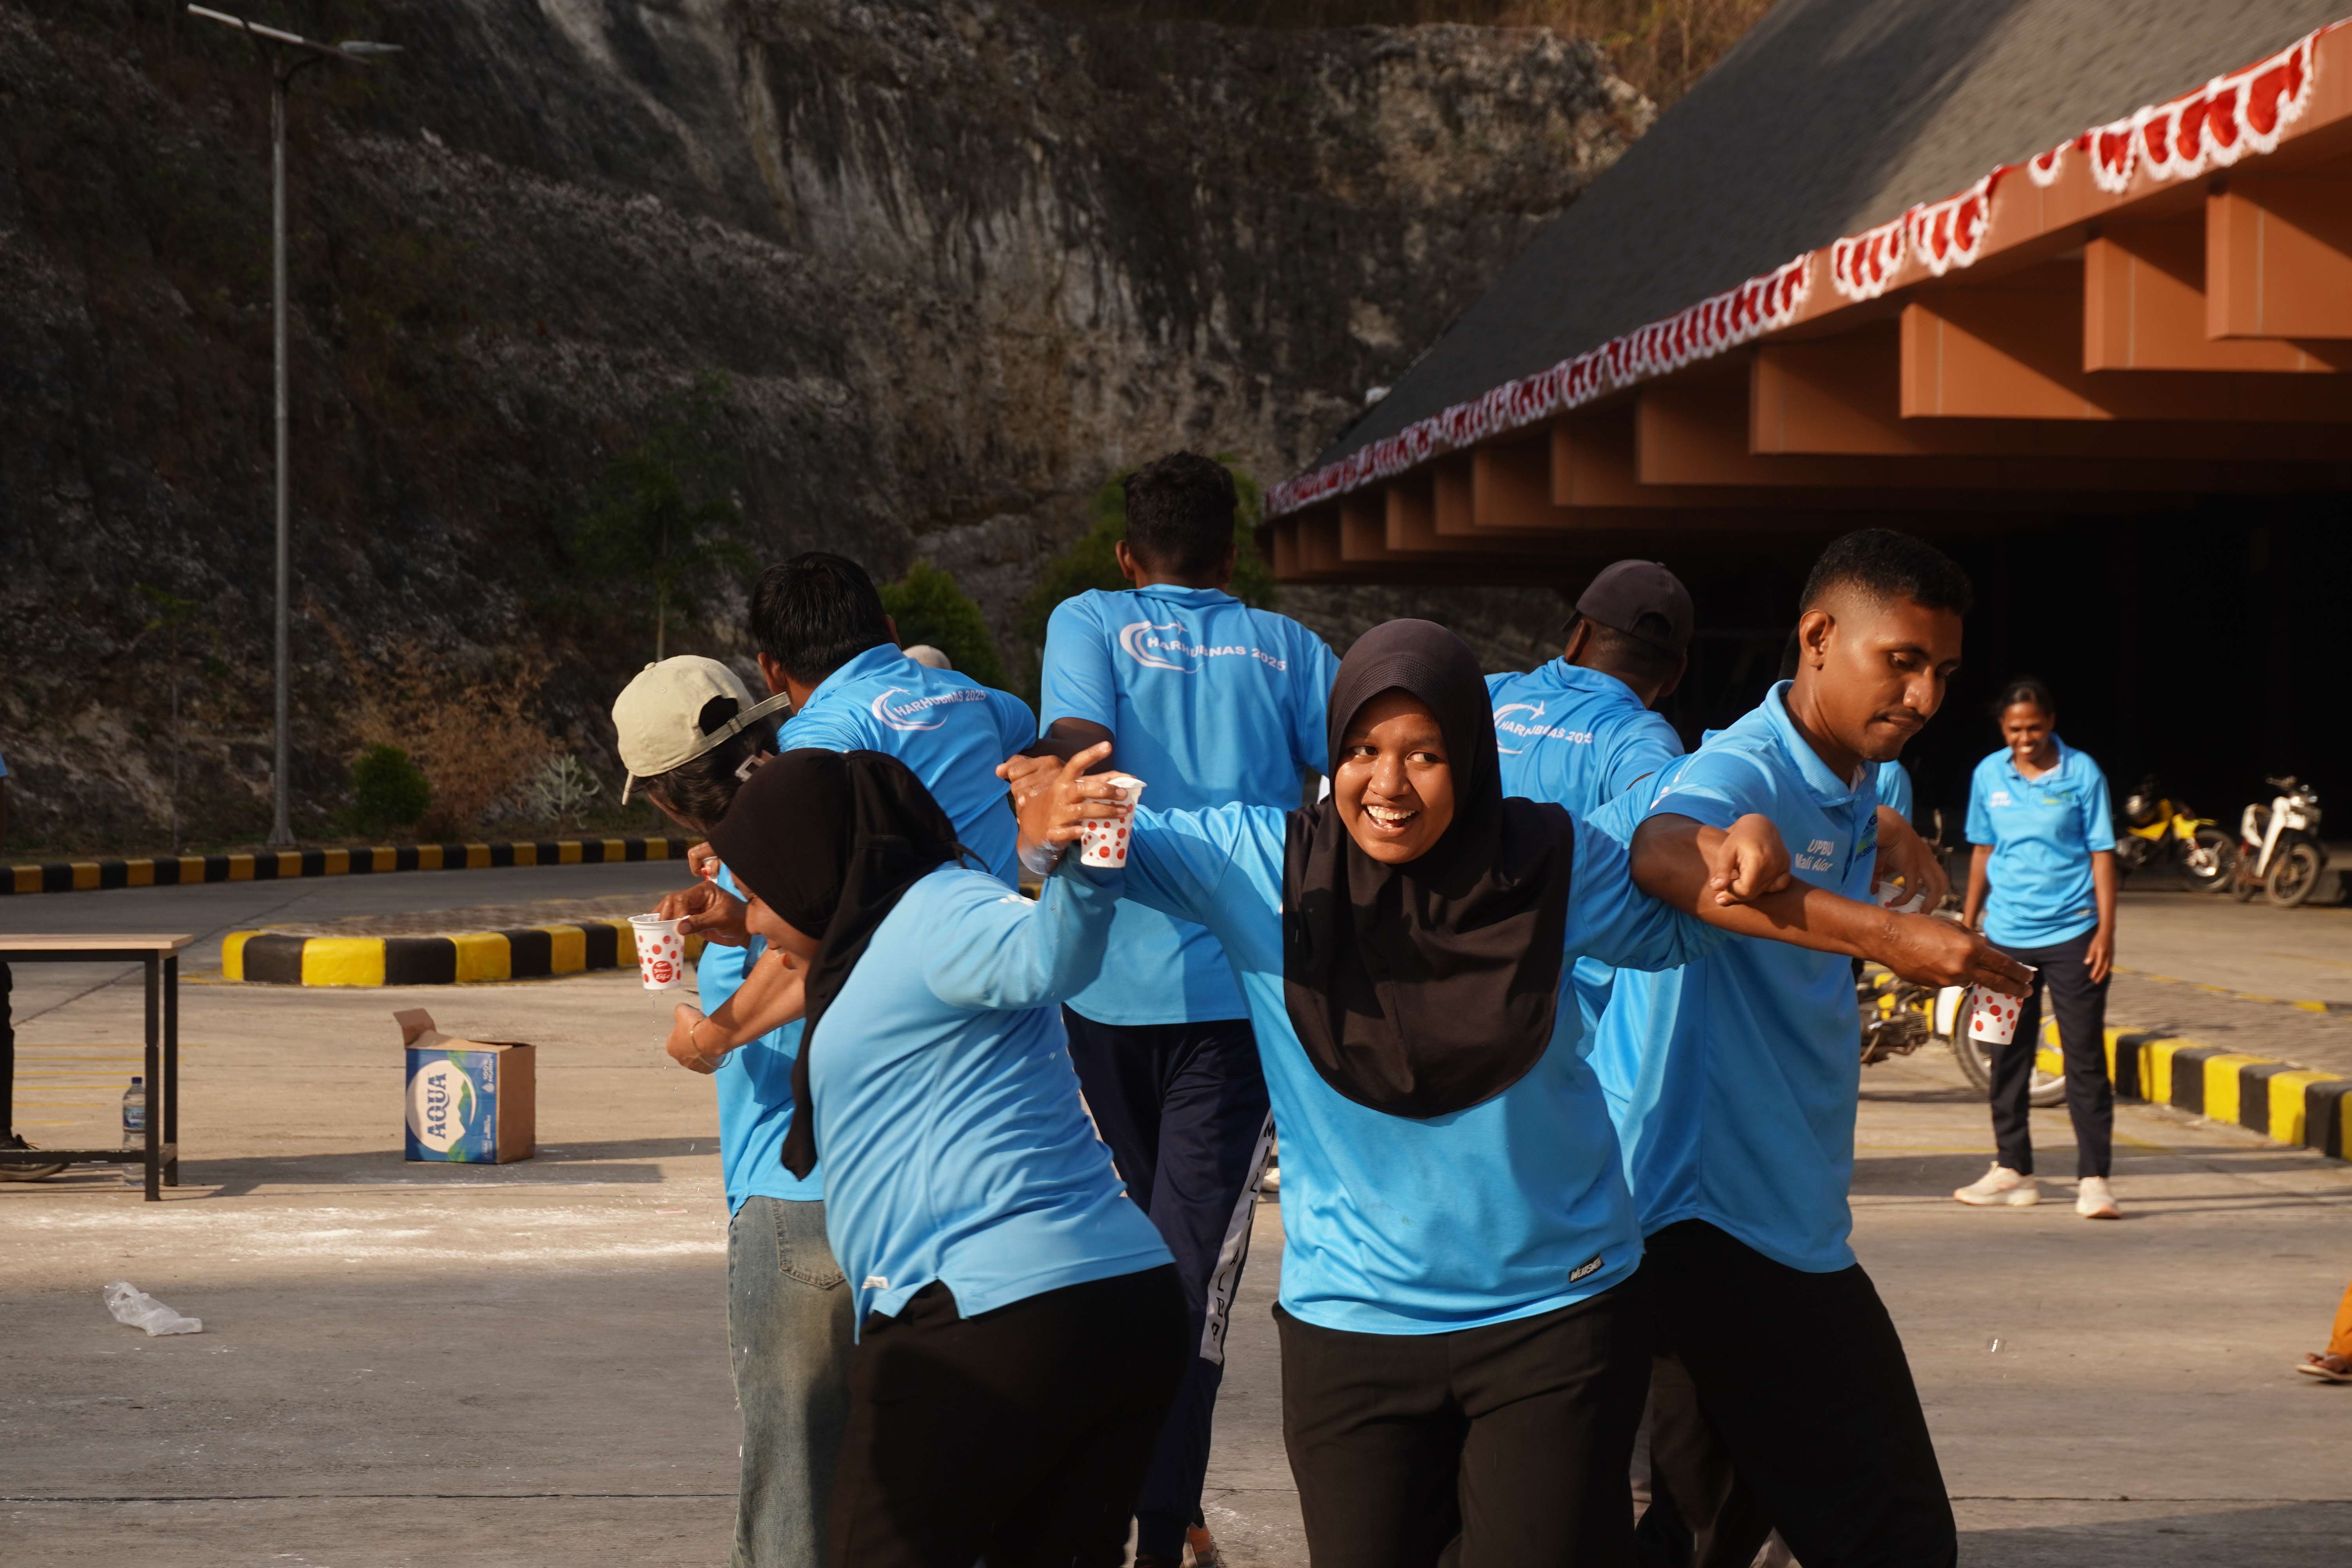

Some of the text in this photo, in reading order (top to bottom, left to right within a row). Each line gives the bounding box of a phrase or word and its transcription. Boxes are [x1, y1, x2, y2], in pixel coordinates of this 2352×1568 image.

[1252, 648, 1287, 671] 2025
[893, 690, 986, 716] HARHUBNAS 2025
[1807, 838, 1834, 856] UPBU
[1812, 858, 1834, 871] Alor
[426, 1073, 450, 1140] AQUA
